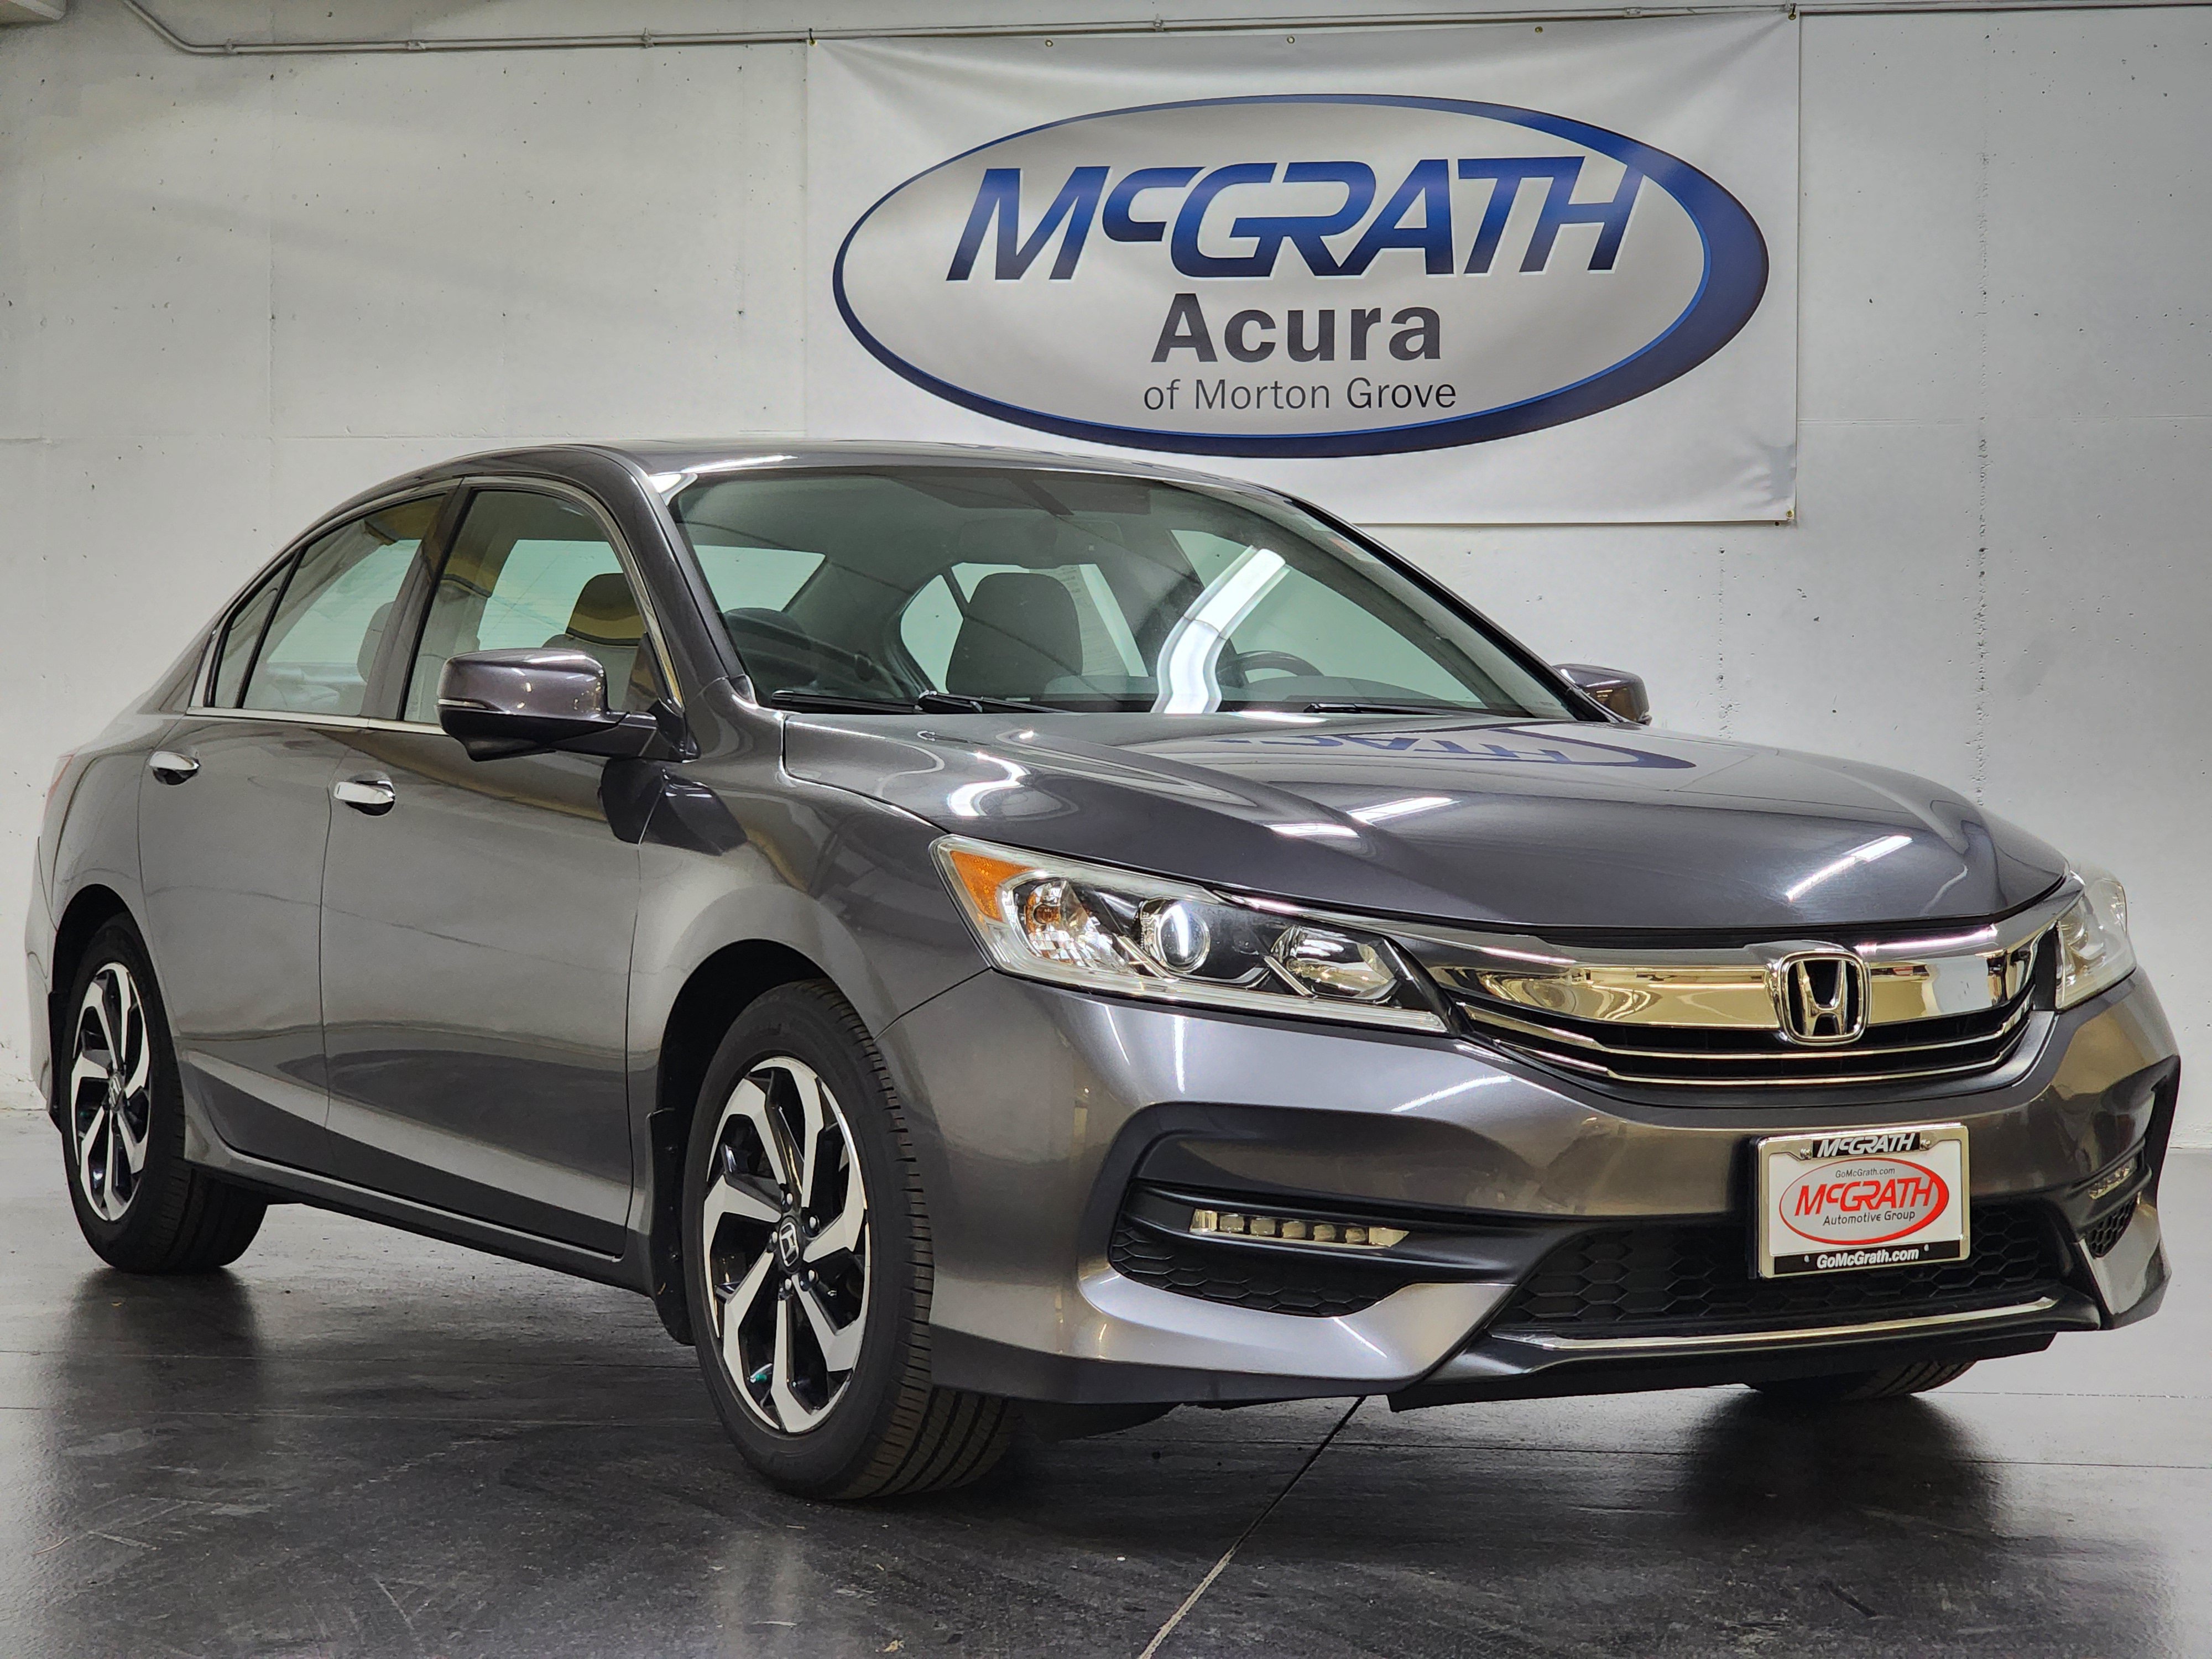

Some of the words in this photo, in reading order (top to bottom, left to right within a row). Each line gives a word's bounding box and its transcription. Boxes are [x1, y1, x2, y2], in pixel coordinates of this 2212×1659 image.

[1151, 293, 1441, 363] Acura
[1143, 378, 1181, 410] of
[1194, 379, 1330, 410] Morton
[1346, 377, 1457, 409] Grove
[1835, 1167, 1896, 1178] GoMcGrath.com
[1823, 1212, 1881, 1226] Automotive
[1884, 1210, 1916, 1223] Group
[1817, 1248, 1919, 1269] GoMcGrath.com
